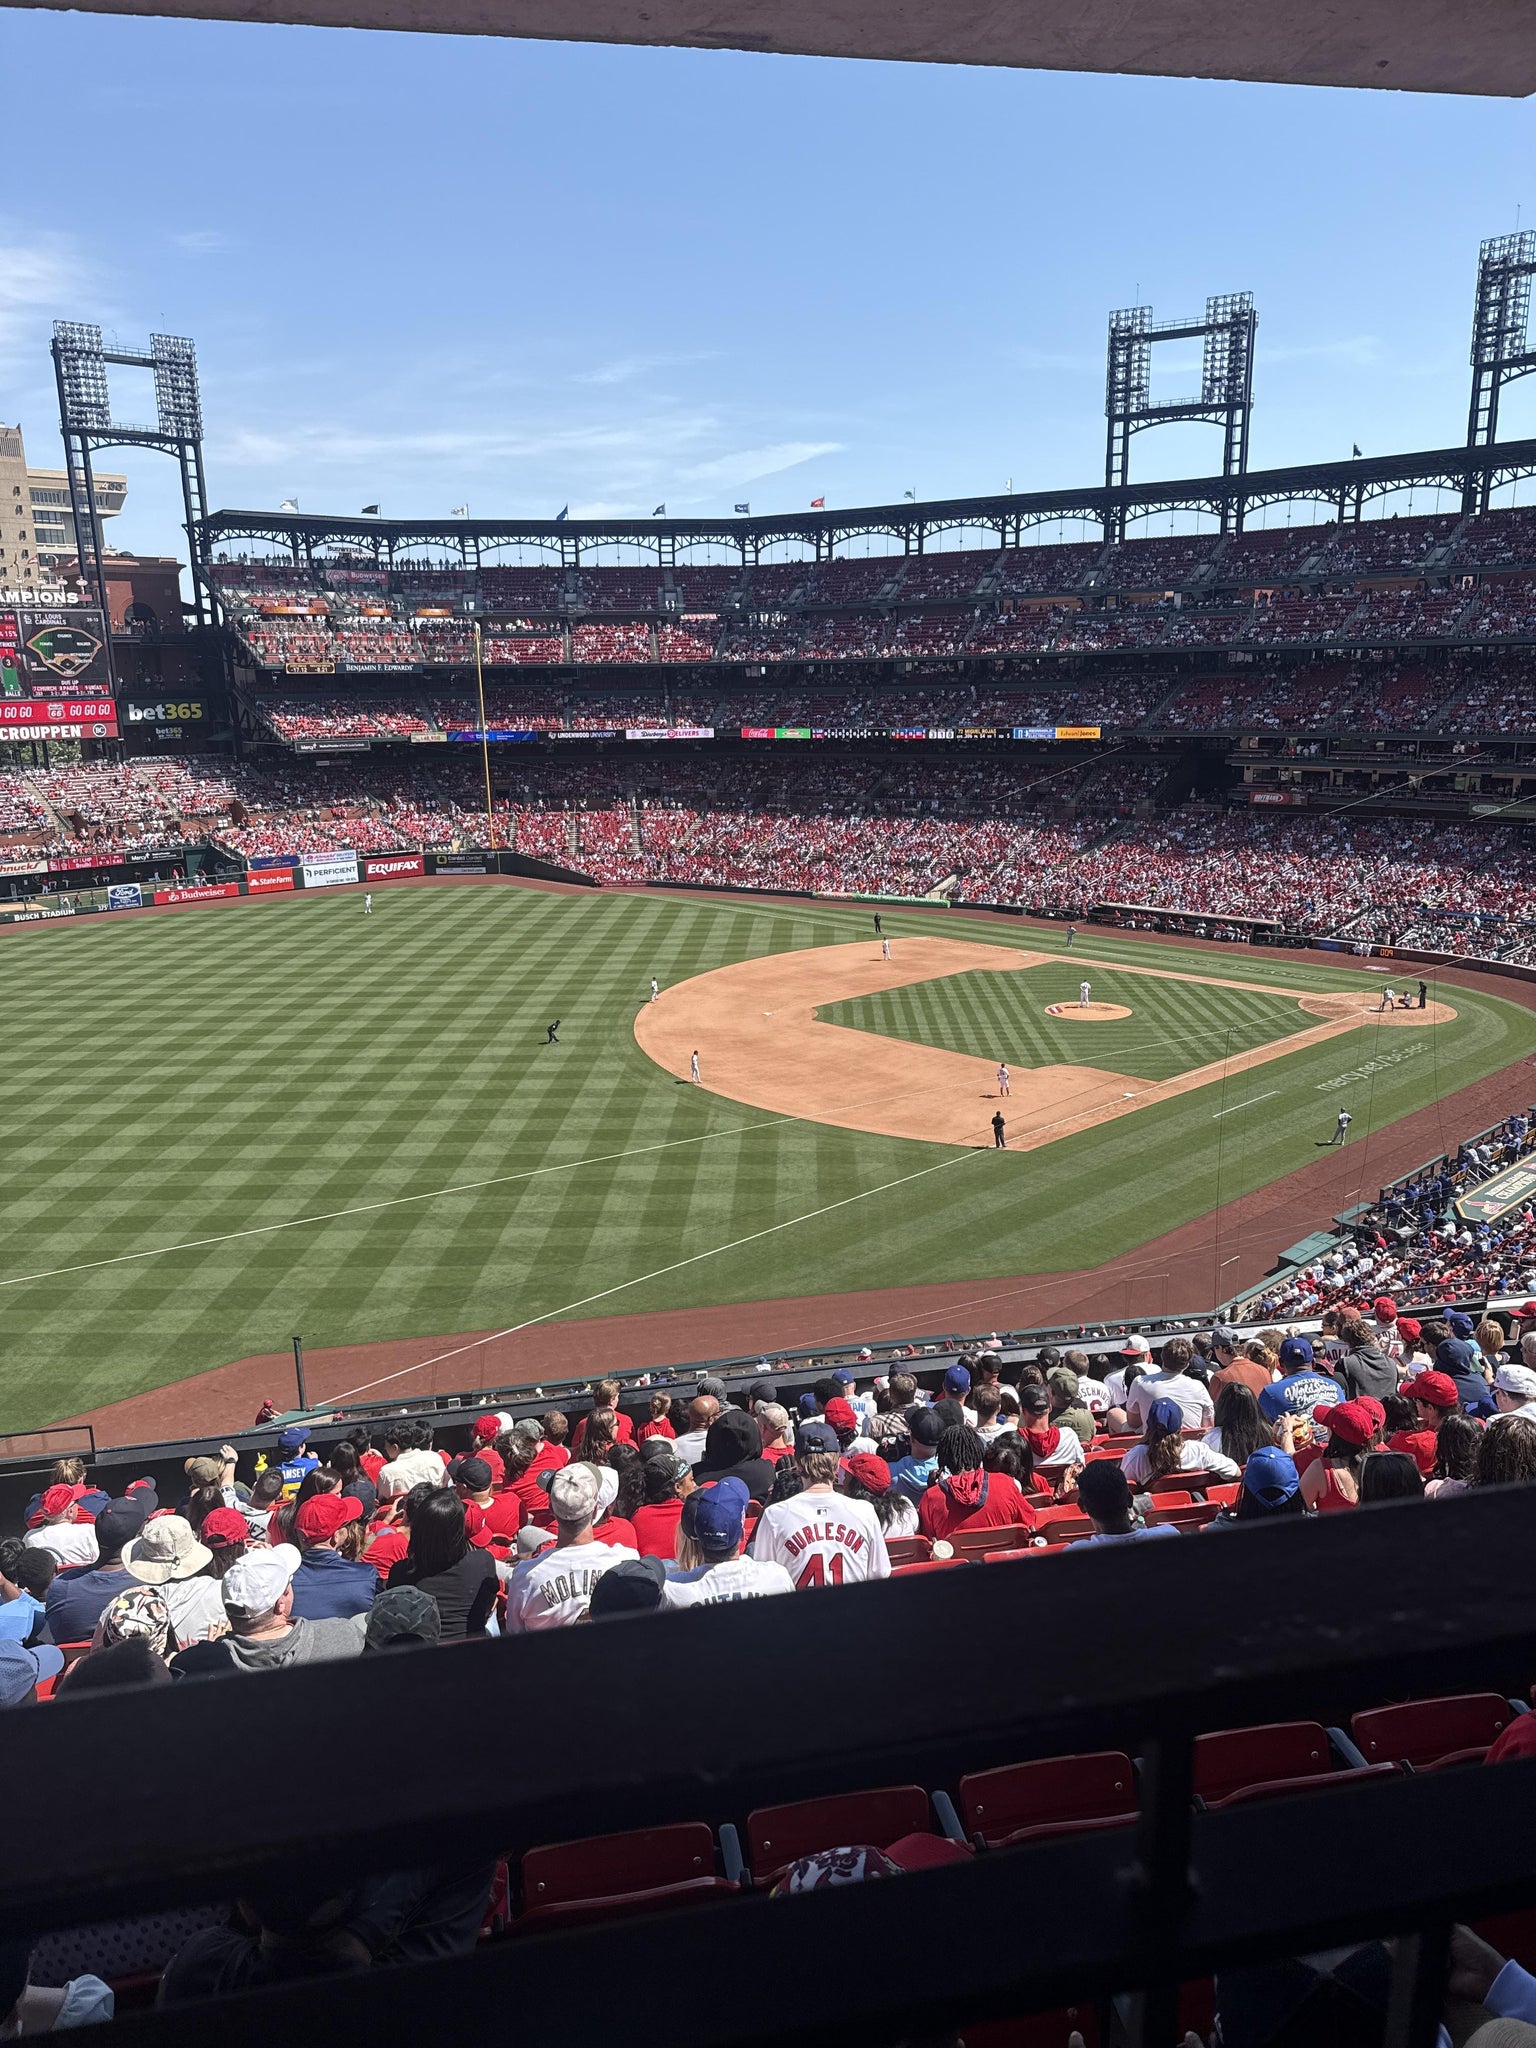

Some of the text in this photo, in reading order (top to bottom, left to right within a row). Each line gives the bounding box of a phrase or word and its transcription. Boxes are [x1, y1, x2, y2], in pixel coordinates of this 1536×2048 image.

[351, 571, 386, 579] BUDWEISER
[5, 706, 32, 718] GO GO
[70, 704, 110, 716] GO GO GO
[128, 703, 202, 720] bet365
[0, 725, 81, 740] CROUPPEN
[0, 862, 41, 872] hnucks
[313, 865, 357, 876] PERFICIENT
[368, 860, 419, 875] EQUIFAX
[114, 887, 134, 897] Ford
[181, 889, 226, 899] Budweiser
[14, 908, 76, 922] BUSCH STADIUM
[1380, 948, 1393, 957] 009
[1284, 1382, 1338, 1401] World Series
[1296, 1391, 1338, 1407] Champions
[784, 1522, 865, 1557] BURLESON
[795, 1552, 844, 1591] 41
